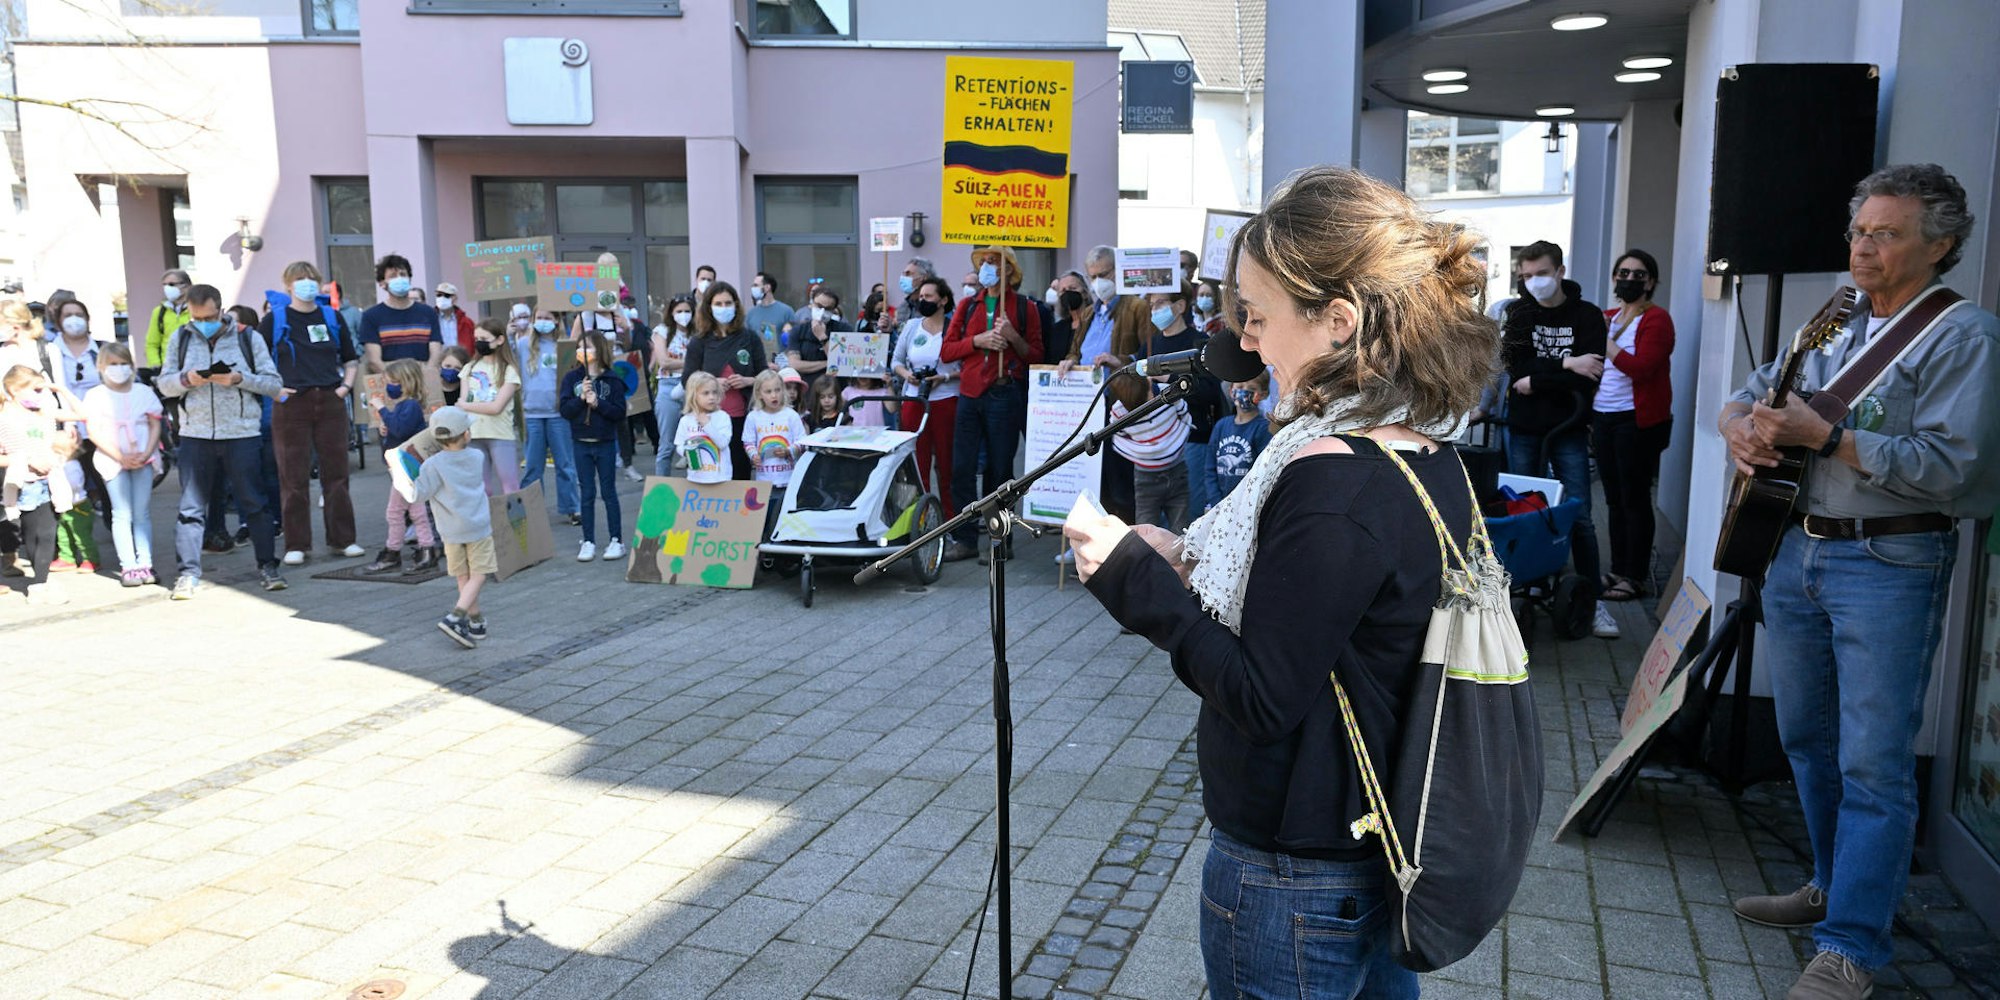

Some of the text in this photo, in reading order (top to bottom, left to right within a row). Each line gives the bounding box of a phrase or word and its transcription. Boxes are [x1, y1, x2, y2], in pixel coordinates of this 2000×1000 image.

[1128, 106, 1174, 115] REGINA
[1128, 115, 1174, 124] HECKEL
[954, 177, 1046, 198] SÜLZ-AUEN
[975, 199, 1052, 210] NICHT WEITER
[598, 265, 620, 280] DIE
[696, 514, 719, 528] den
[691, 532, 755, 561] FORST
